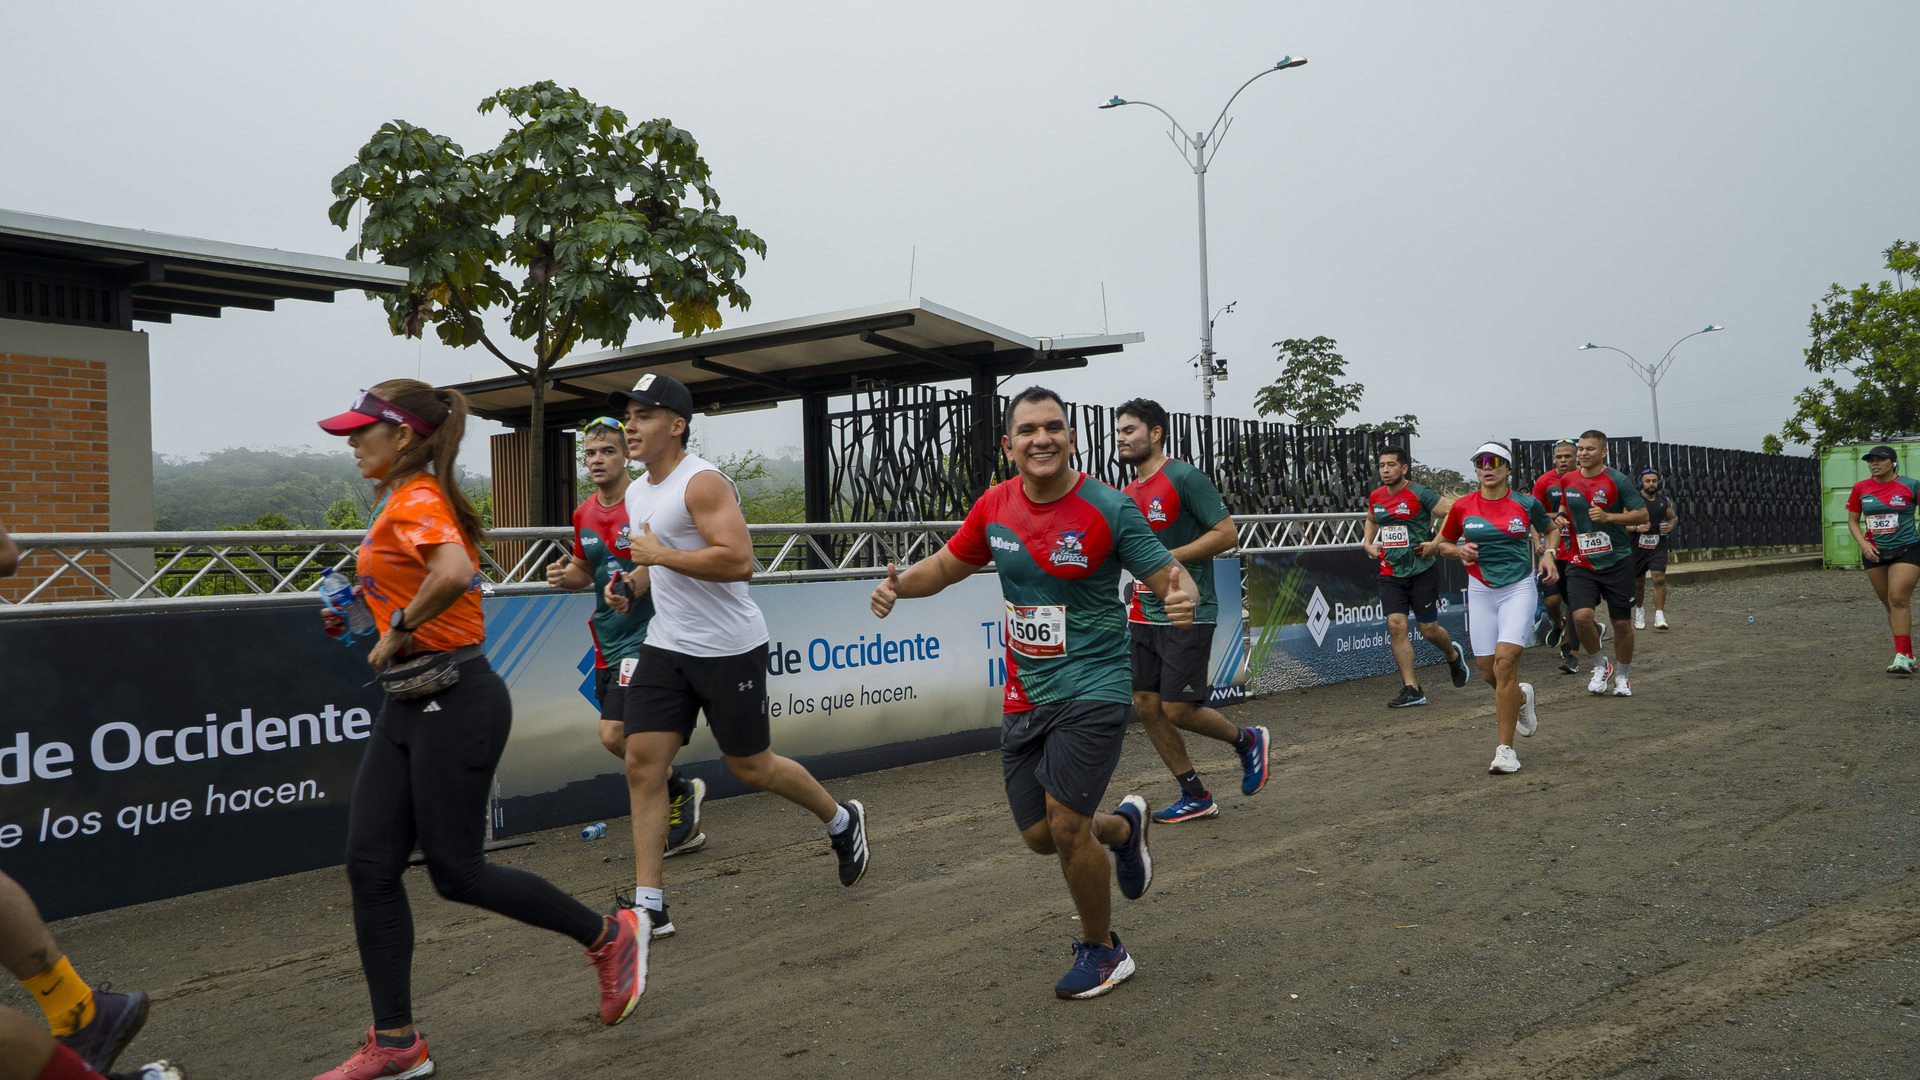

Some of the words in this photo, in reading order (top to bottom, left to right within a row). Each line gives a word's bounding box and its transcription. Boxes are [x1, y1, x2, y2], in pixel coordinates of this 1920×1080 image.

[1873, 520, 1890, 528] 362
[1385, 532, 1403, 541] 1460
[1584, 538, 1602, 548] 749
[1335, 602, 1373, 625] Banco
[1010, 618, 1051, 642] 1506
[1336, 636, 1351, 652] Del
[1352, 633, 1371, 649] lado
[1373, 630, 1383, 646] de
[767, 642, 801, 676] de
[808, 633, 940, 672] Occidente
[788, 693, 815, 716] los
[820, 692, 855, 716] que
[860, 685, 917, 706] hacen.
[1210, 686, 1244, 701] AVAL
[0, 732, 74, 785] de
[90, 704, 372, 772] Occidente
[39, 808, 103, 842] los
[116, 799, 193, 835] que
[205, 779, 326, 816] hacen.
